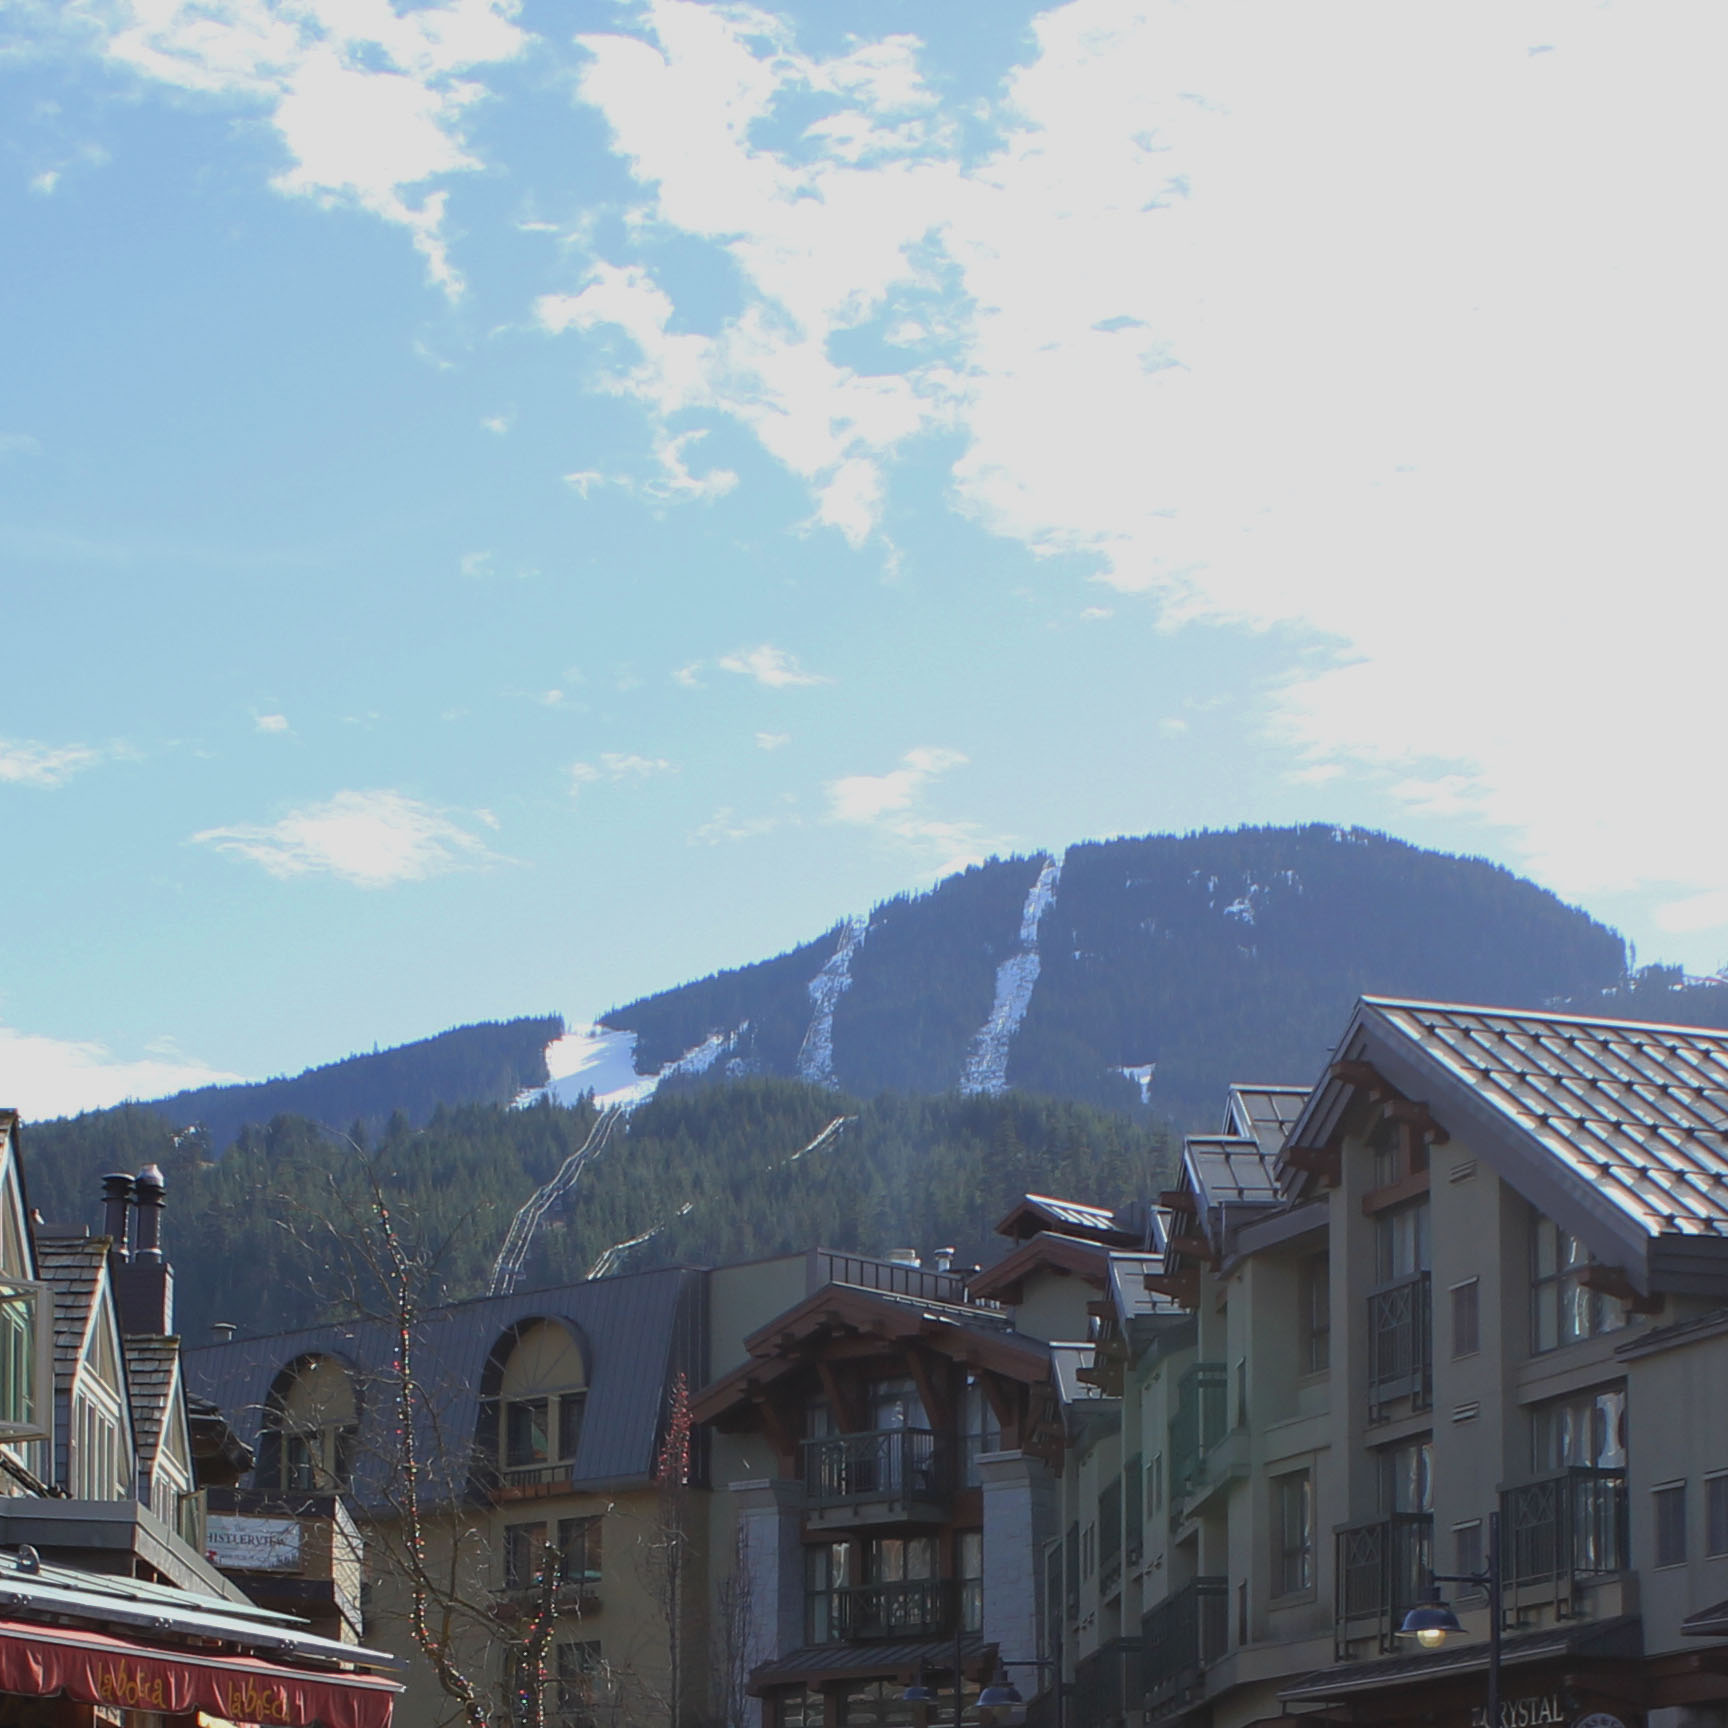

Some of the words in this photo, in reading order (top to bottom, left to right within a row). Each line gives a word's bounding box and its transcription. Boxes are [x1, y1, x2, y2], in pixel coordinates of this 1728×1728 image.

[207, 1532, 286, 1547] HISTLERVIEW
[98, 1661, 113, 1701] la
[228, 1680, 243, 1718] la
